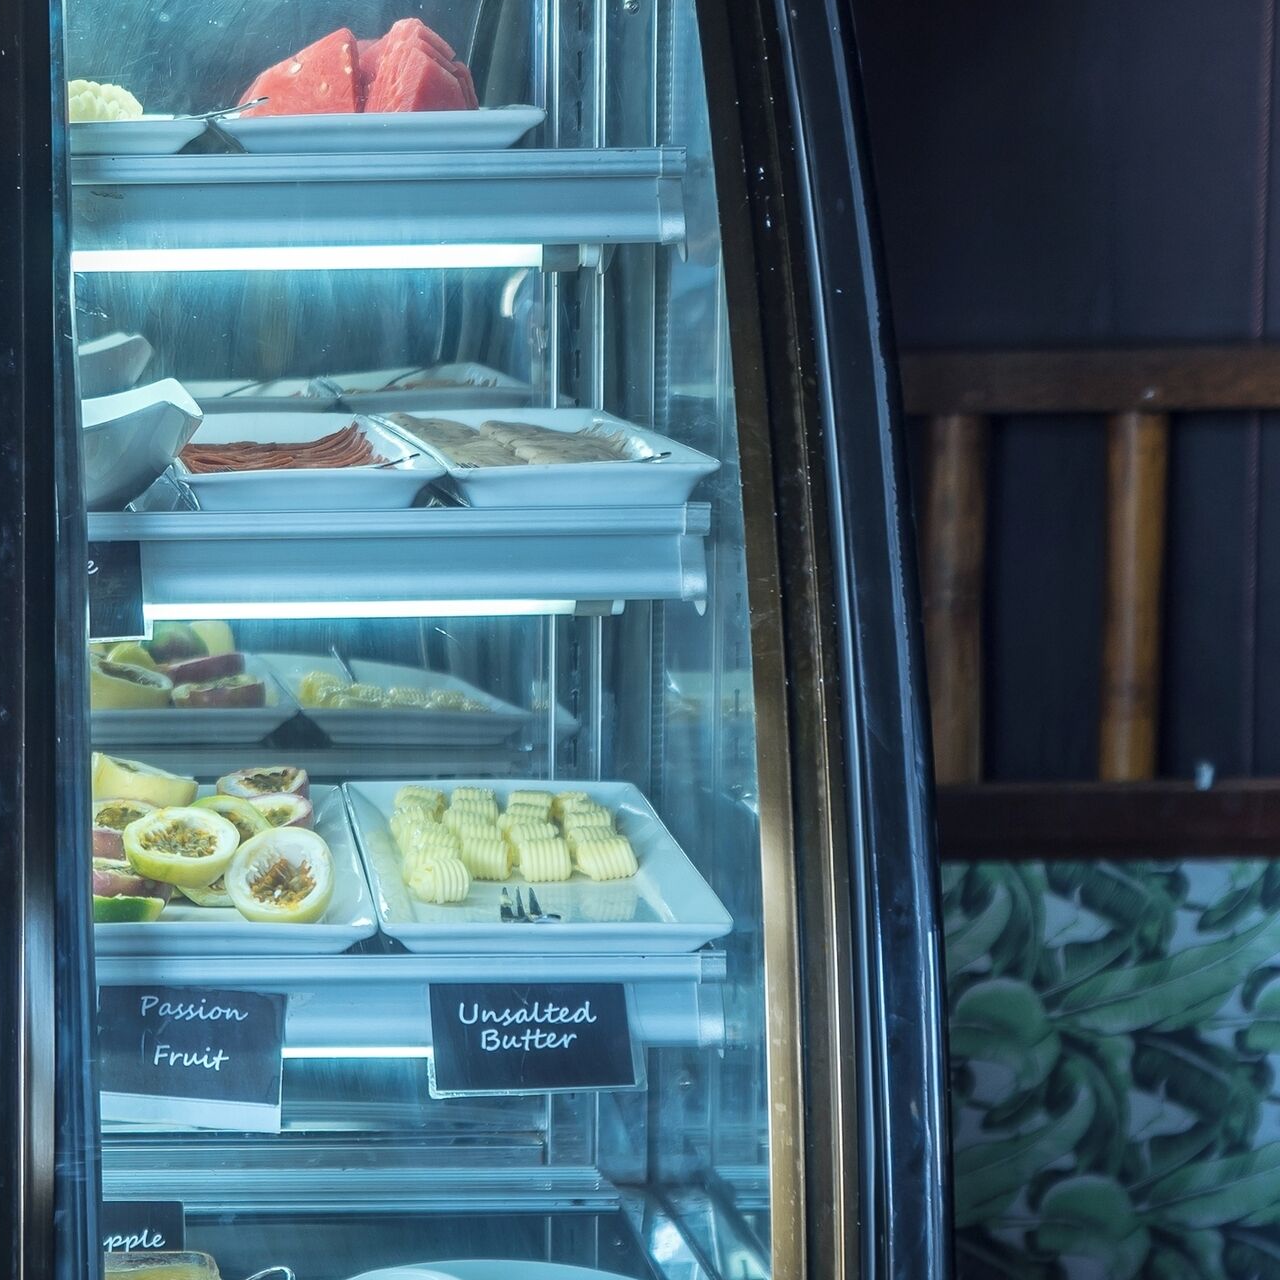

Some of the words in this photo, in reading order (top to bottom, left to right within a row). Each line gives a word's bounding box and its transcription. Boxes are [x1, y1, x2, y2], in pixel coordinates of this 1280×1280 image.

[140, 995, 249, 1022] Passion
[458, 1000, 598, 1027] Unsalted
[480, 1027, 578, 1051] Butter
[153, 1044, 230, 1071] Fruit
[103, 1228, 167, 1253] pple
